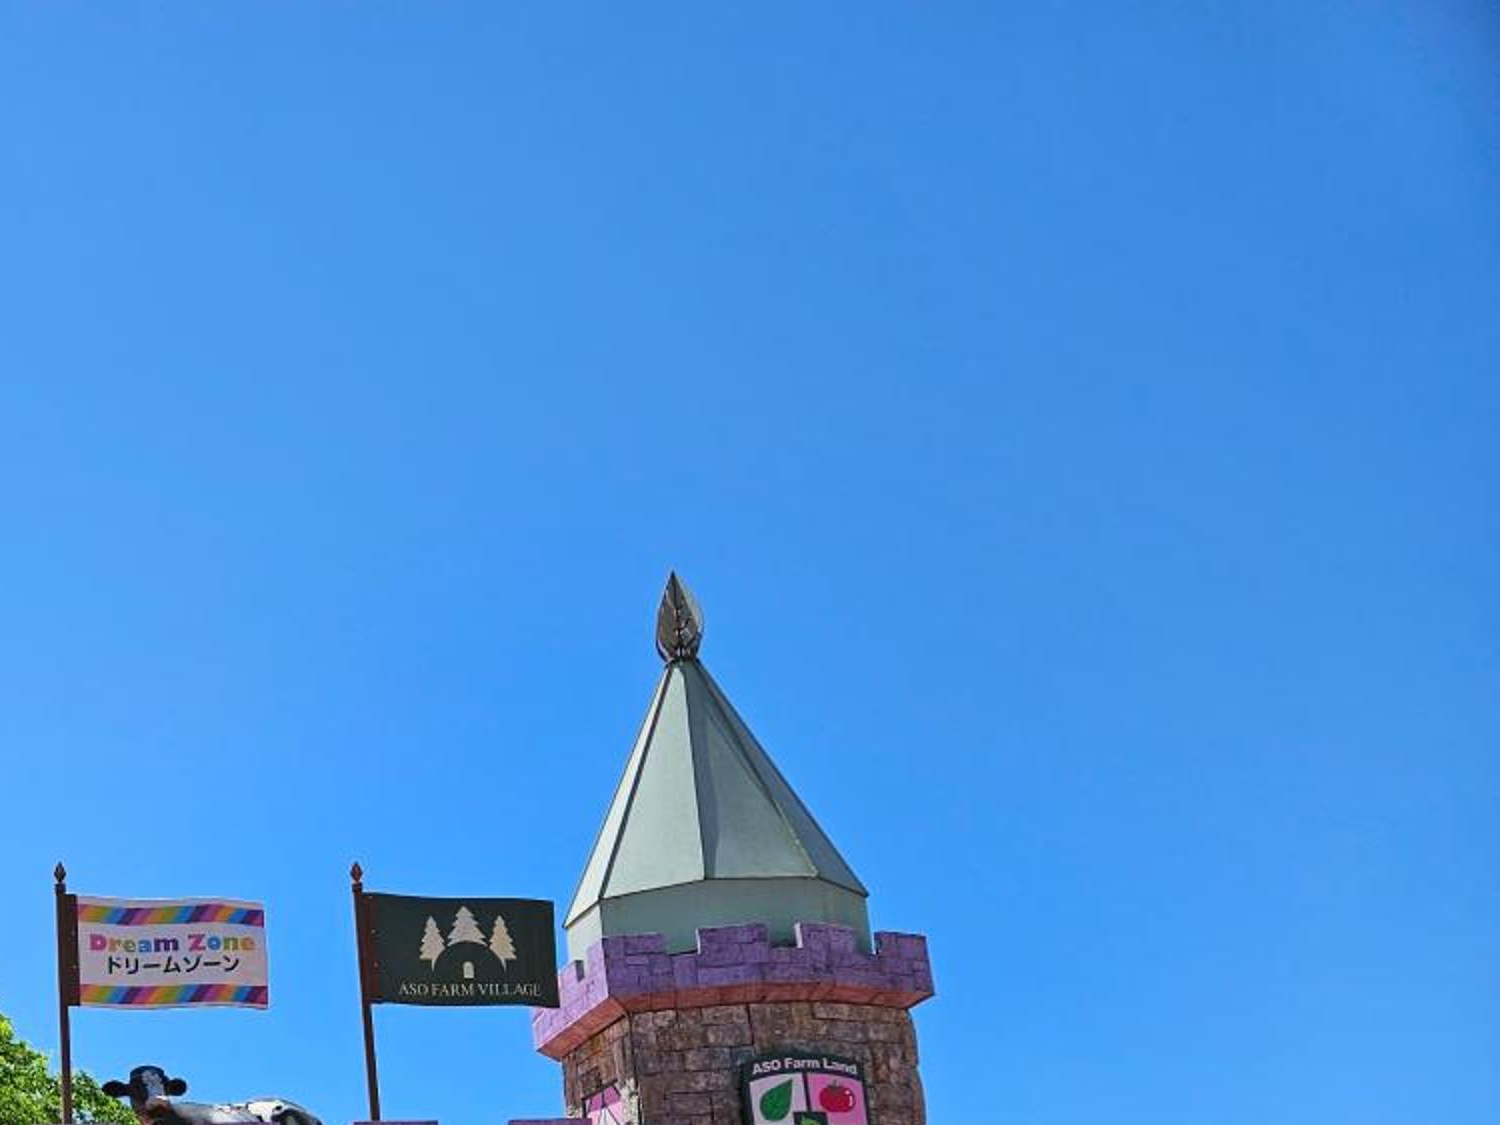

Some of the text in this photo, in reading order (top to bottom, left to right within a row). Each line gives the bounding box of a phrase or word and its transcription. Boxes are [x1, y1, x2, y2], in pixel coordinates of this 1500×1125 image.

[89, 933, 256, 953] Dream Zone
[107, 954, 240, 975] ドリームゾーン
[398, 983, 542, 998] ASO FARM VILLAGE
[752, 1057, 858, 1075] ASO Farm Land
